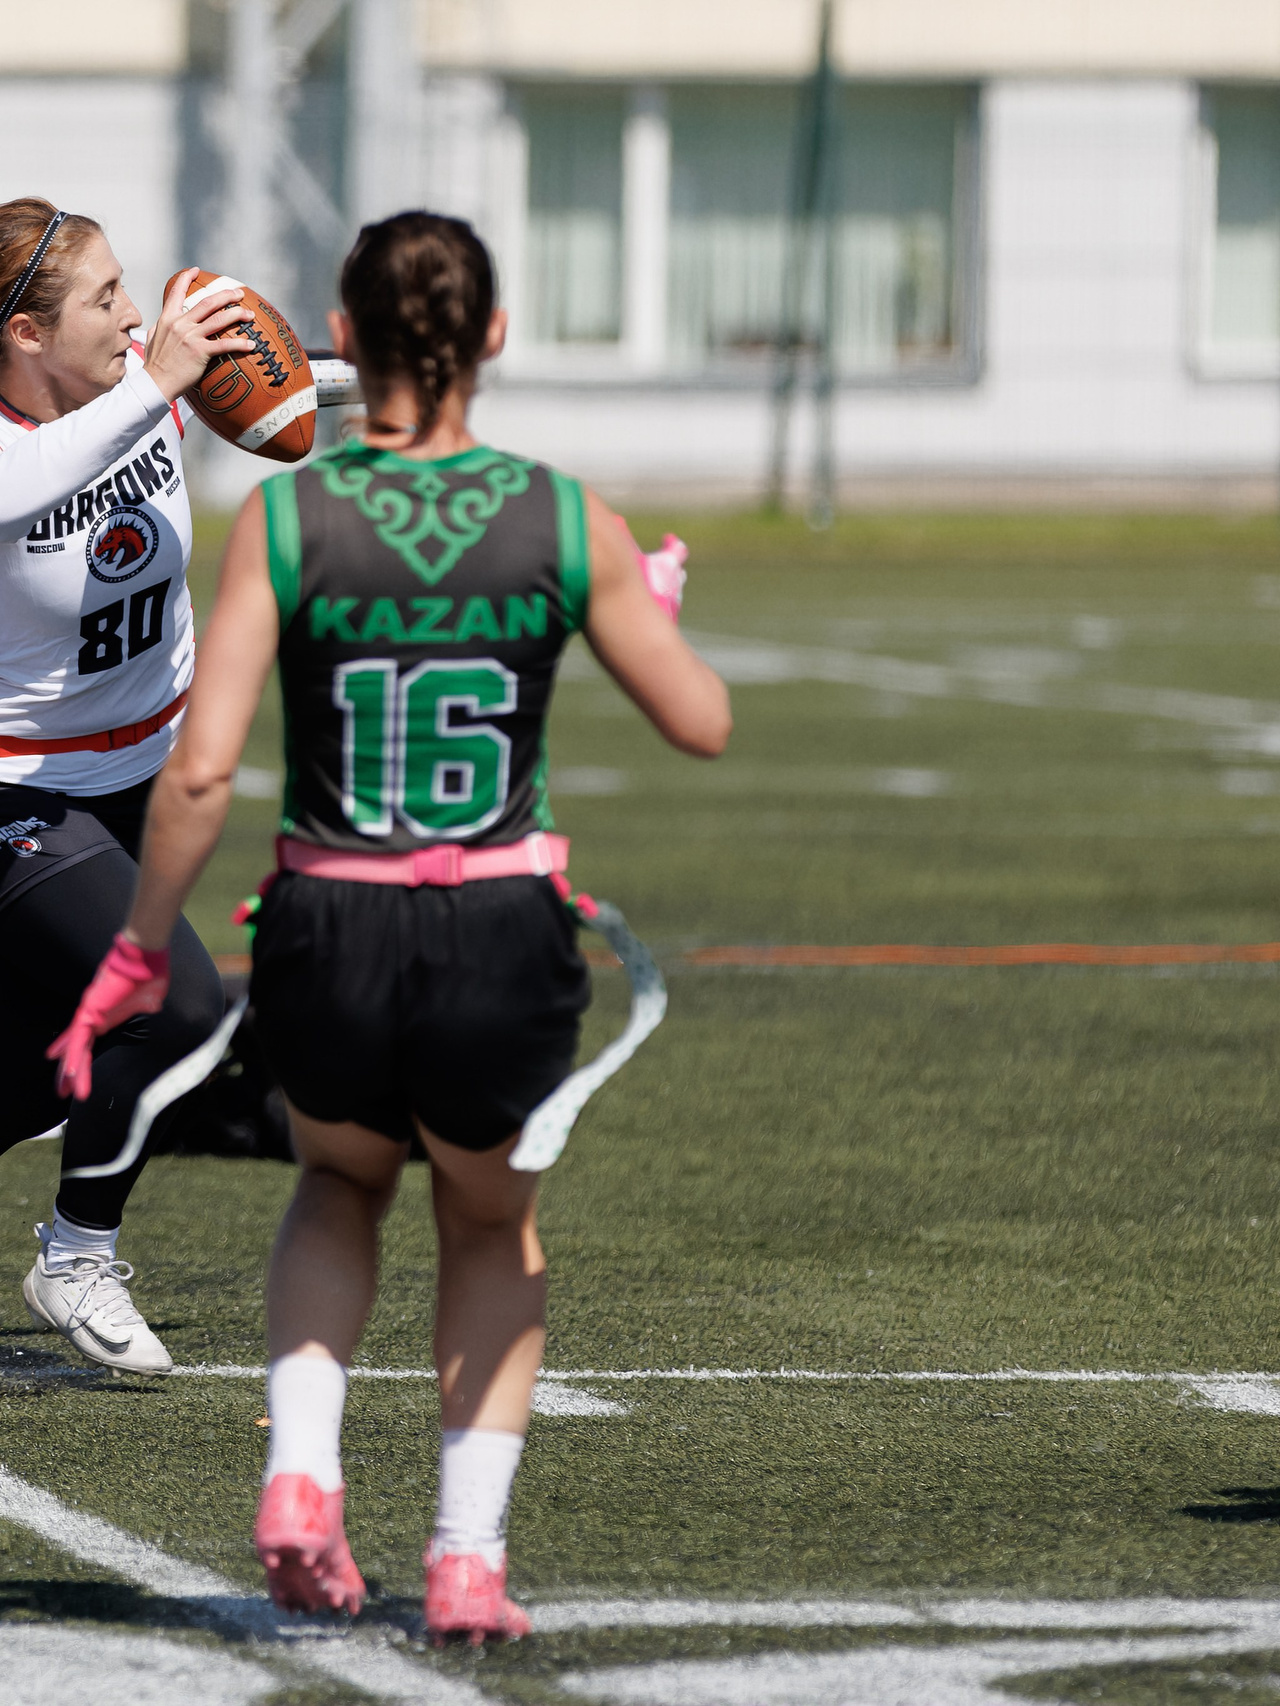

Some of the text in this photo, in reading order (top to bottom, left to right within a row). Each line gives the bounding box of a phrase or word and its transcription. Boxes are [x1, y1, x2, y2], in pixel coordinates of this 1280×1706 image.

[258, 302, 303, 369] Wilson
[26, 542, 66, 554] MOSCOW
[78, 577, 172, 675] 80
[309, 594, 549, 643] KAZAN
[333, 658, 518, 839] 16
